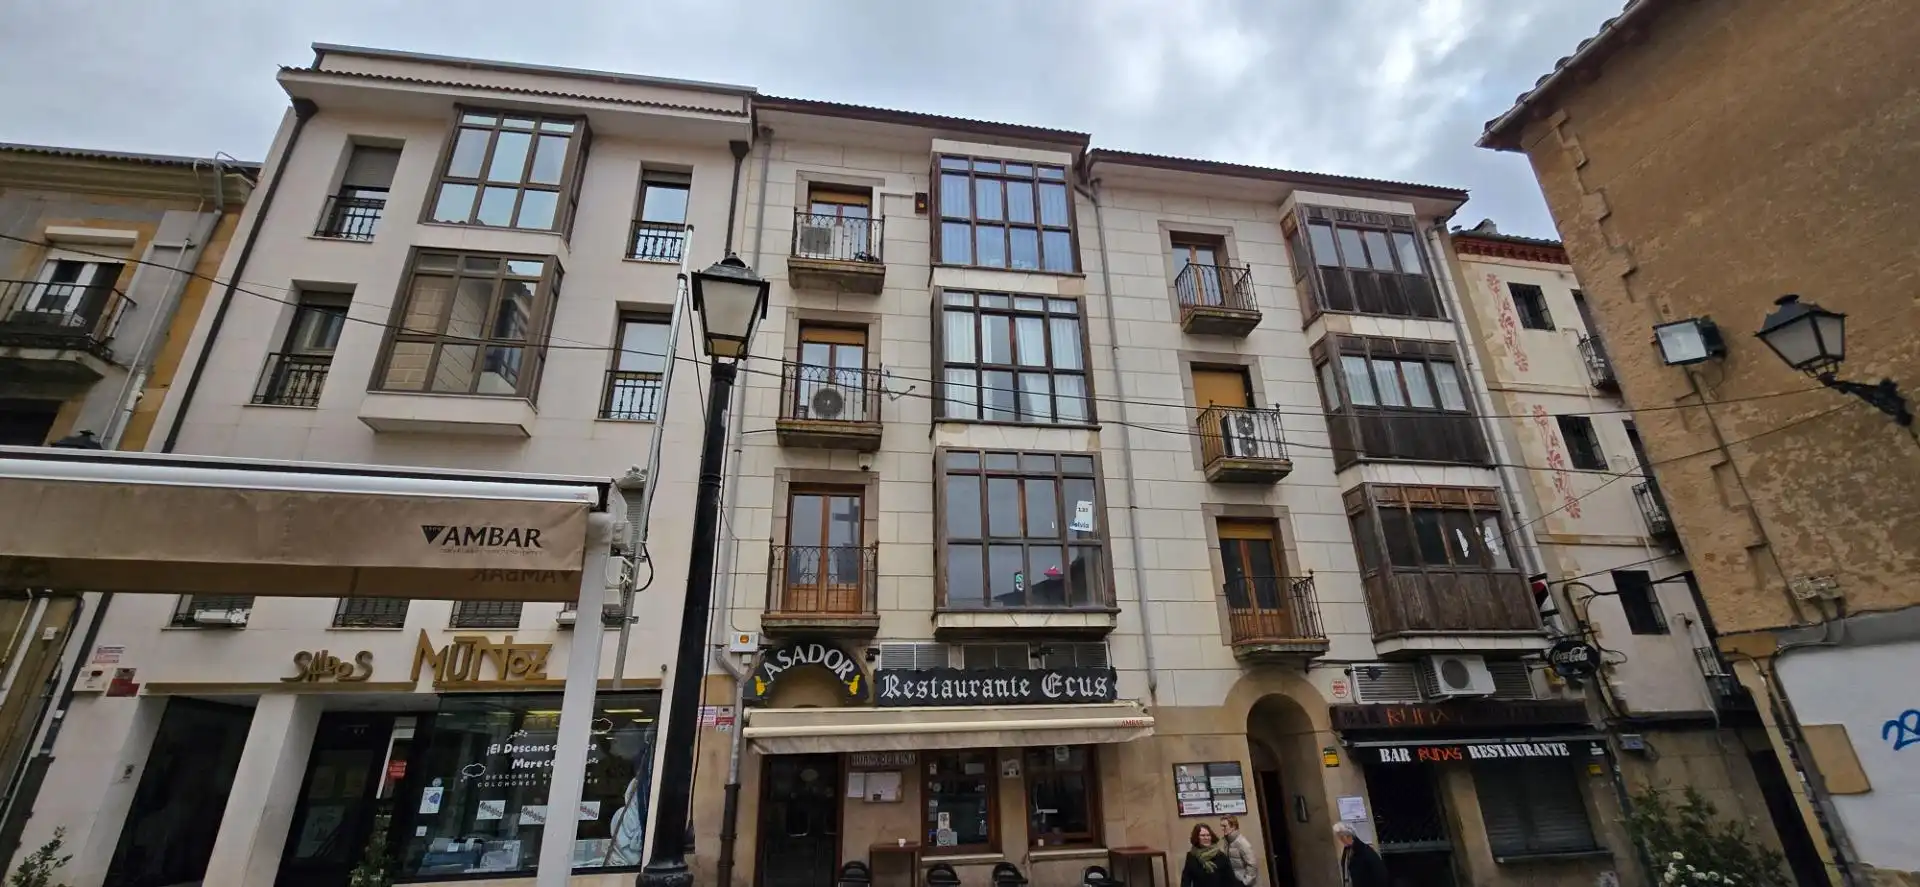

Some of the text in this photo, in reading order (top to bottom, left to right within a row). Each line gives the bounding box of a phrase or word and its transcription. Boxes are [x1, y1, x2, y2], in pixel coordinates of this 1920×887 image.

[441, 526, 543, 548] AMBAR
[763, 644, 855, 681] ASADOR
[880, 672, 1108, 699] Restaurante Ecus
[486, 743, 501, 756] ¡El
[1380, 747, 1411, 763] BAR
[1466, 743, 1570, 759] RESTAURANTE
